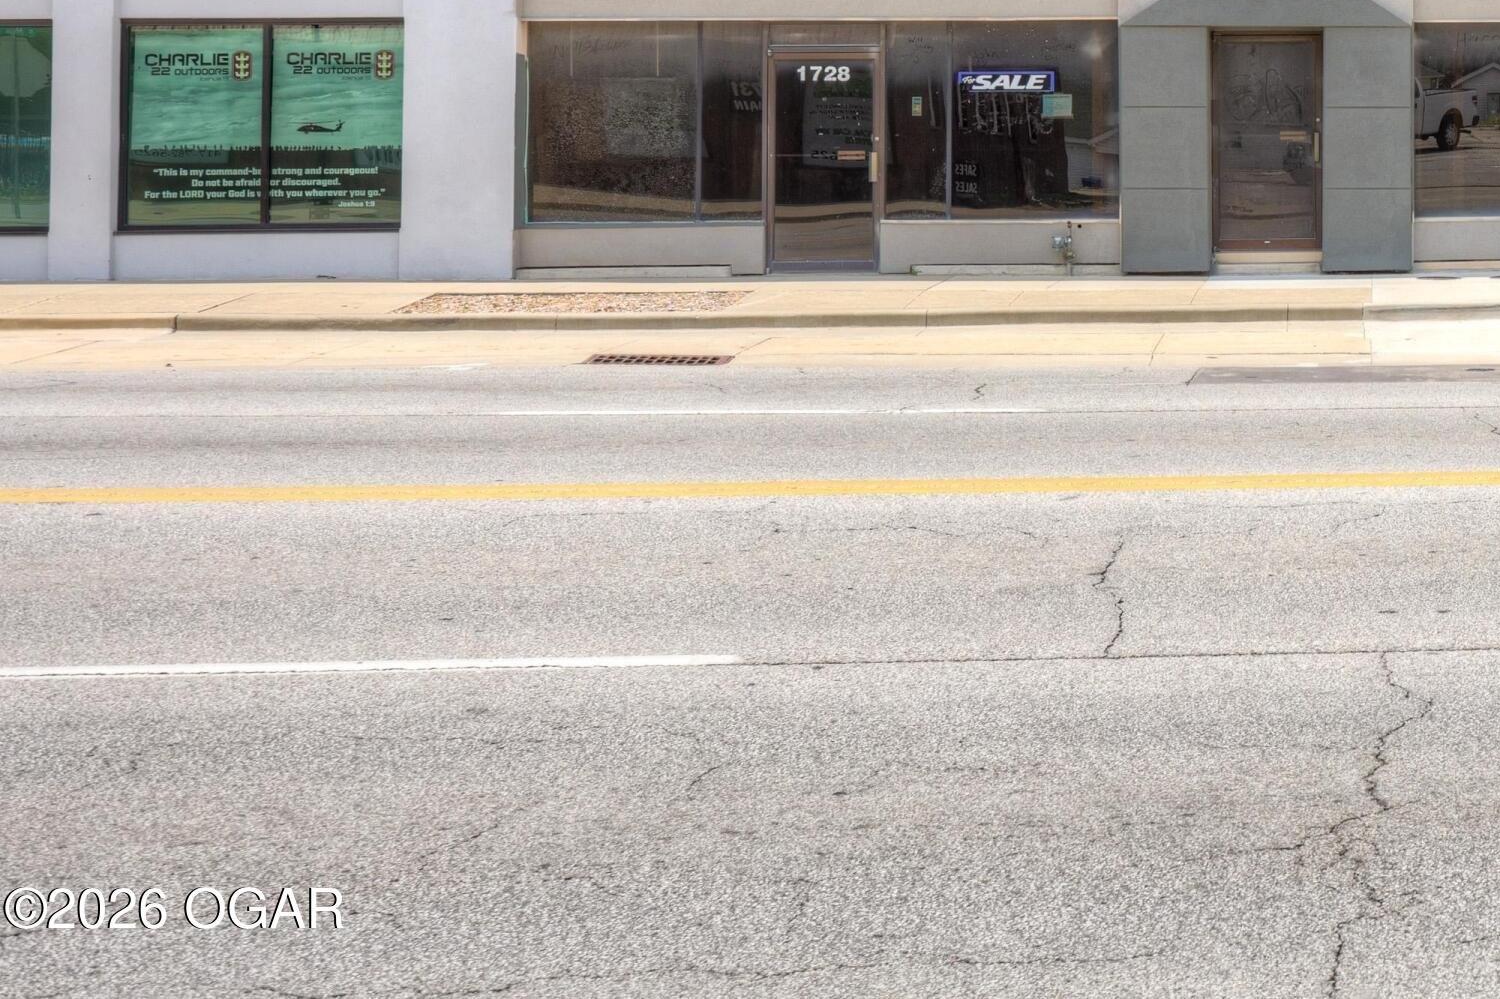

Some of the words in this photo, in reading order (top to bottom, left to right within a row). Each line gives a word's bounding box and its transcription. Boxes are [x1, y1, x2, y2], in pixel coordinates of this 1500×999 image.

[145, 53, 229, 66] CHARLIE
[287, 52, 371, 65] CHARLIE
[151, 67, 171, 76] 22
[293, 65, 312, 74] 22
[797, 65, 851, 82] 1728
[961, 75, 976, 85] For
[972, 74, 1047, 90] SALE
[179, 167, 188, 176] is
[190, 169, 204, 178] my
[272, 167, 303, 176] strong
[304, 166, 322, 175] and
[323, 166, 379, 176] courageous!
[191, 179, 204, 187] Do
[205, 179, 221, 187] not
[222, 178, 234, 187] be
[235, 178, 261, 187] afraid
[282, 177, 341, 187] discouraged.
[144, 190, 160, 199] For
[162, 190, 178, 198] the
[180, 189, 204, 198] LORD
[206, 191, 227, 200] your
[228, 189, 246, 198] God
[247, 189, 255, 198] is
[286, 190, 303, 198] you
[304, 188, 348, 197] wherever
[349, 189, 366, 198] you
